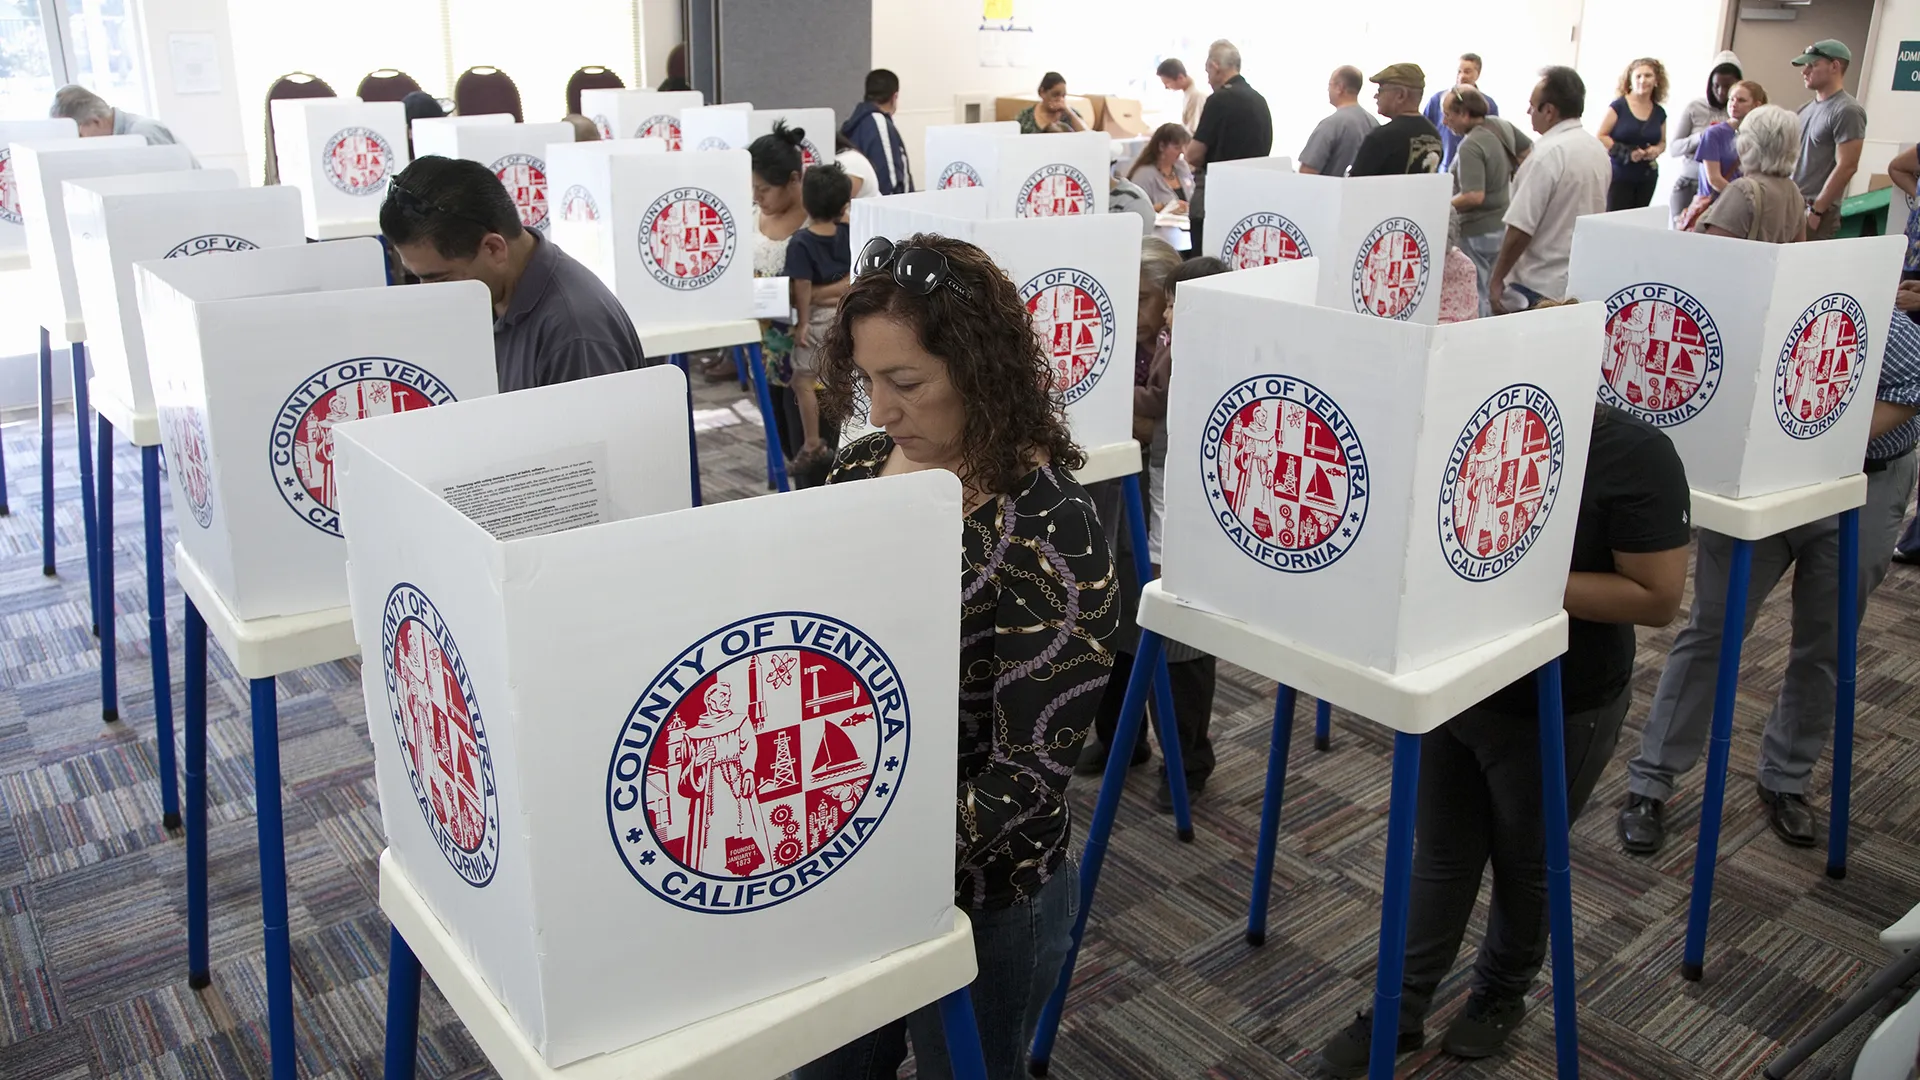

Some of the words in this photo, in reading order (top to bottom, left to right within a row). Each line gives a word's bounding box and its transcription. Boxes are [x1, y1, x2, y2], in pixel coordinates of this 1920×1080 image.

[1898, 51, 1920, 62] ADMI
[640, 196, 669, 245] COUNTY
[674, 190, 691, 199] OF
[696, 190, 734, 240] VENTURA
[1017, 172, 1043, 214] COUNTY
[1047, 166, 1060, 174] OF
[1064, 166, 1094, 209] VENTURA
[196, 238, 218, 250] OF
[1258, 215, 1274, 224] OF
[1278, 218, 1310, 258] VENTU
[1354, 228, 1382, 281] COUNTY
[1386, 220, 1400, 230] OF
[1404, 221, 1428, 274] VENTURA
[654, 264, 724, 288] CALIFORNIA
[1045, 272, 1066, 285] OF
[1072, 272, 1113, 338] VENTURA
[1606, 288, 1636, 319] NTY
[1642, 286, 1668, 298] OF
[1674, 292, 1720, 372] VENTURA
[1777, 305, 1818, 377] COUNTY
[1821, 296, 1838, 310] OF
[1841, 298, 1867, 366] VENTURA
[274, 373, 329, 466] COUNTY
[338, 362, 373, 380] OF
[382, 362, 450, 406] VENT
[1204, 382, 1258, 460] COUNTY
[1265, 379, 1296, 396] OF
[1304, 387, 1366, 501] VENTURA
[1781, 401, 1848, 436] CALIFORNIA
[1442, 402, 1492, 505] COUNTY
[1498, 388, 1521, 409] OF
[1525, 388, 1562, 476] VENTURA
[1220, 510, 1342, 569] CALIFORNIA
[1451, 524, 1542, 578] CALIFORNIA
[386, 591, 404, 692] COUNTY
[408, 592, 428, 620] OF
[433, 614, 494, 798] VENTURA
[613, 647, 706, 812] COUNTY
[720, 621, 774, 656] OF
[790, 620, 904, 744] VENTURA
[411, 769, 492, 880] CALIFORNIA
[730, 844, 756, 856] FOUNDED
[661, 816, 878, 908] CALIFORNIA
[728, 852, 752, 864] JANUARY
[736, 858, 751, 868] 1873
